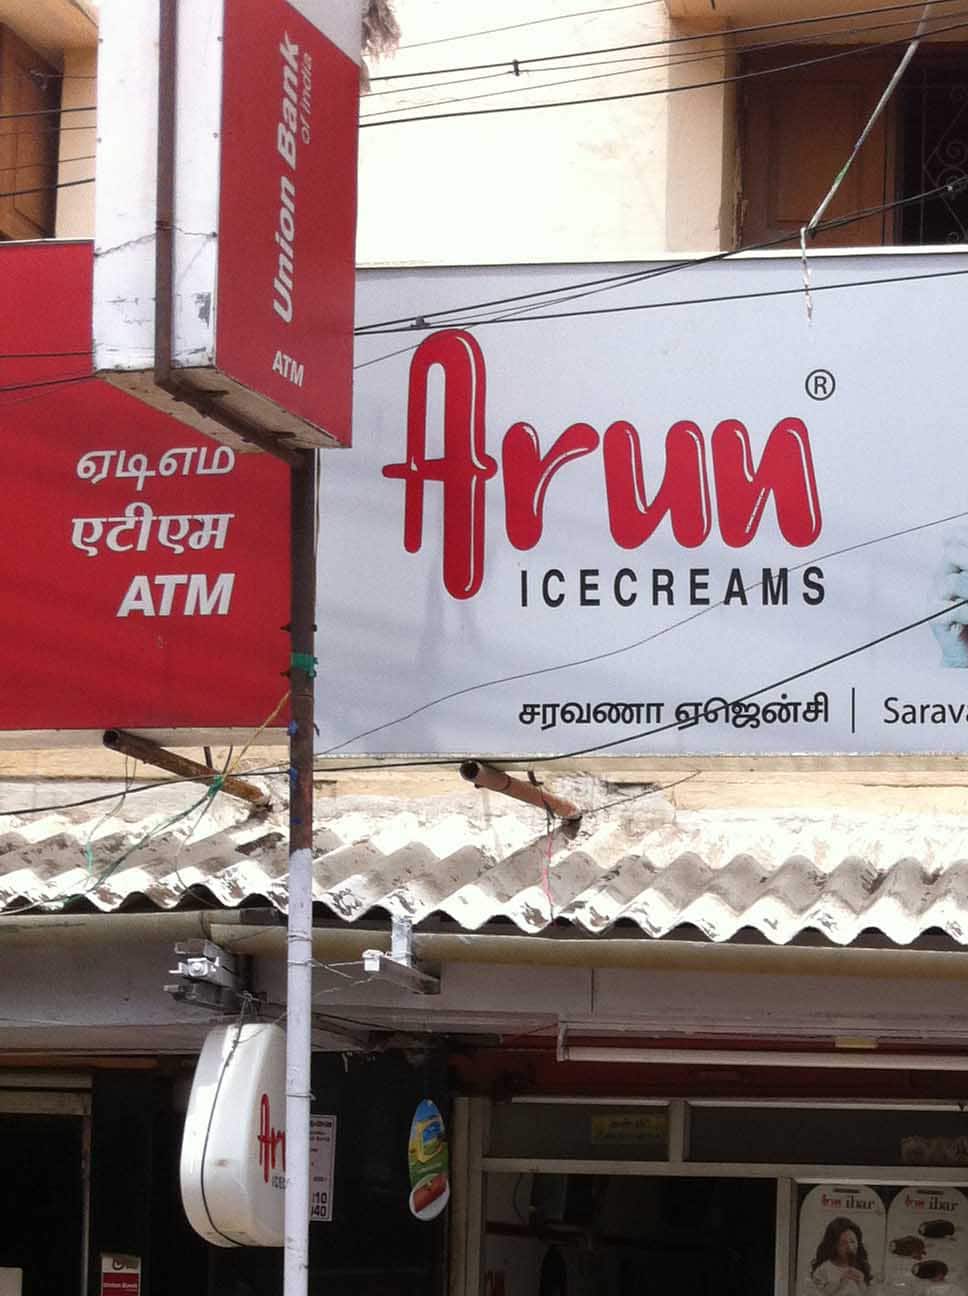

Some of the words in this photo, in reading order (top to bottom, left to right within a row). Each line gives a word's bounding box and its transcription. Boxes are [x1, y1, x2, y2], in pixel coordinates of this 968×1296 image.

[277, 31, 298, 170] Bank
[301, 54, 312, 111] India
[301, 116, 311, 145] of
[273, 176, 295, 324] Union
[272, 350, 304, 388] ATM
[382, 328, 823, 600] Arun
[72, 502, 235, 557] एटीएम
[116, 573, 235, 617] ATM
[520, 567, 826, 608] ICECREAMS
[518, 702, 664, 731] சரவணா
[675, 692, 828, 731] ஏஜென்சி
